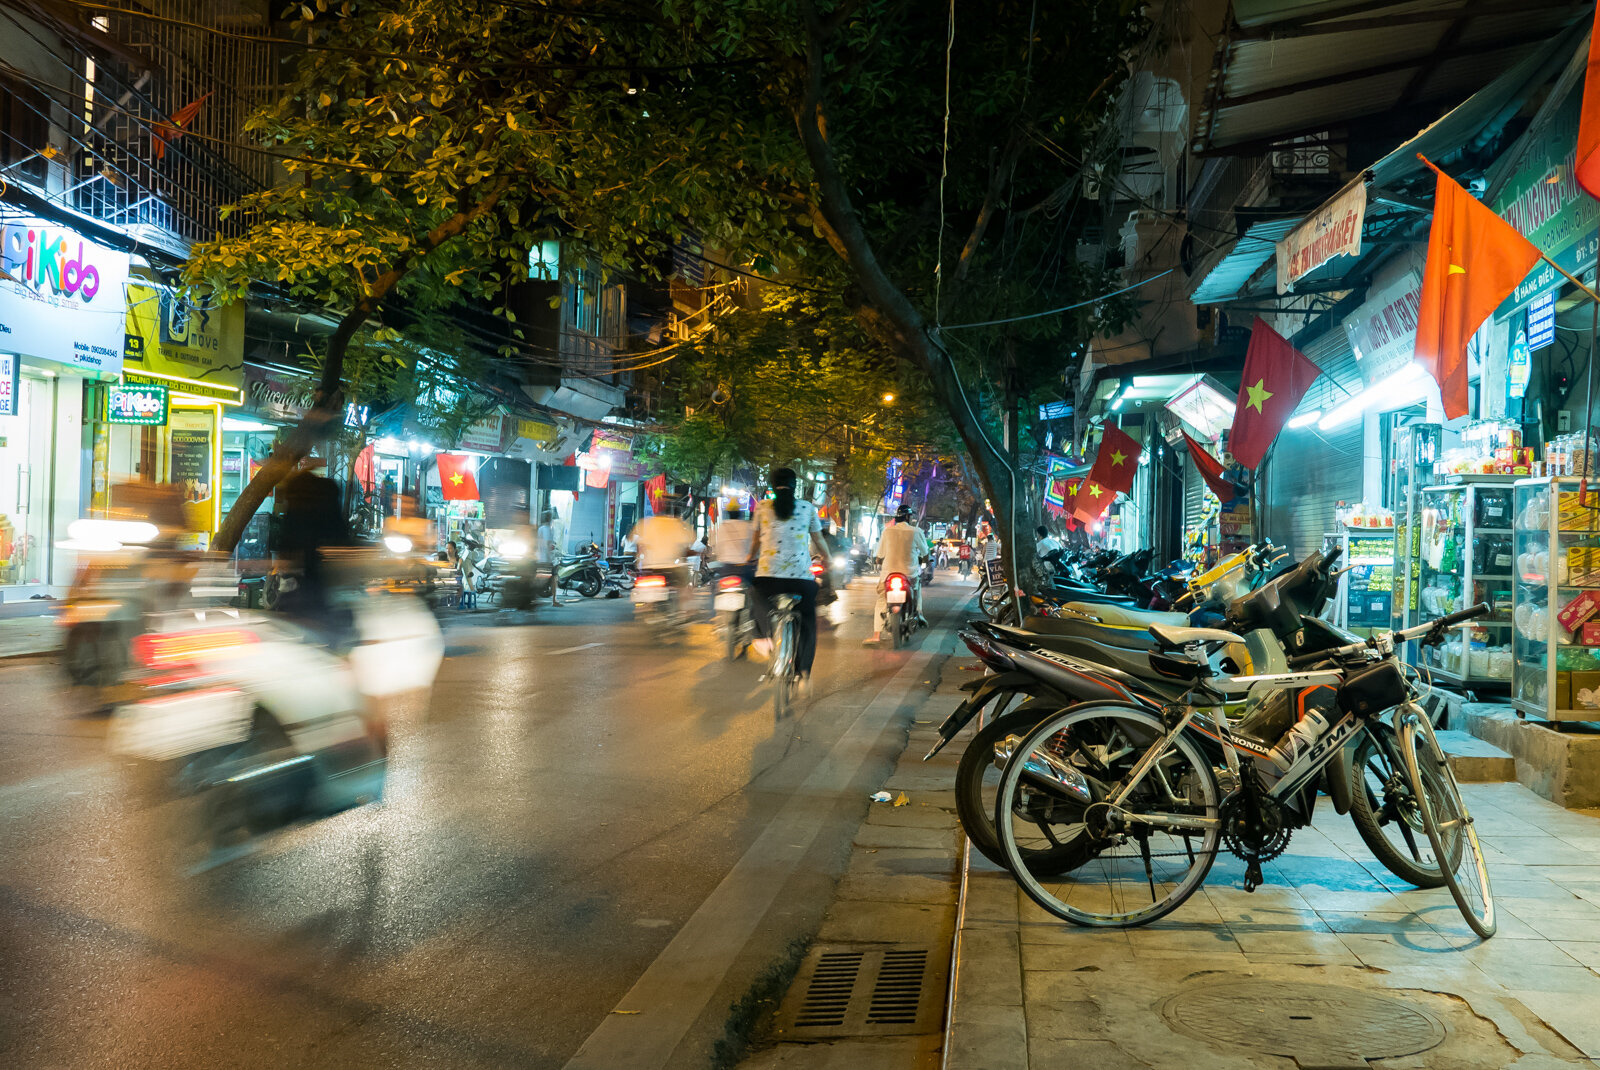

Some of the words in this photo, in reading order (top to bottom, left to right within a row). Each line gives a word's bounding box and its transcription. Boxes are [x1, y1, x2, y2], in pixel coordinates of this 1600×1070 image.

[1514, 286, 1520, 302] 8
[1393, 297, 1416, 333] SEN
[128, 338, 139, 349] 13
[190, 333, 219, 350] move
[126, 374, 151, 385] TRUNG
[0, 381, 11, 395] CE
[0, 399, 10, 411] GE
[1230, 735, 1270, 755] HONDA
